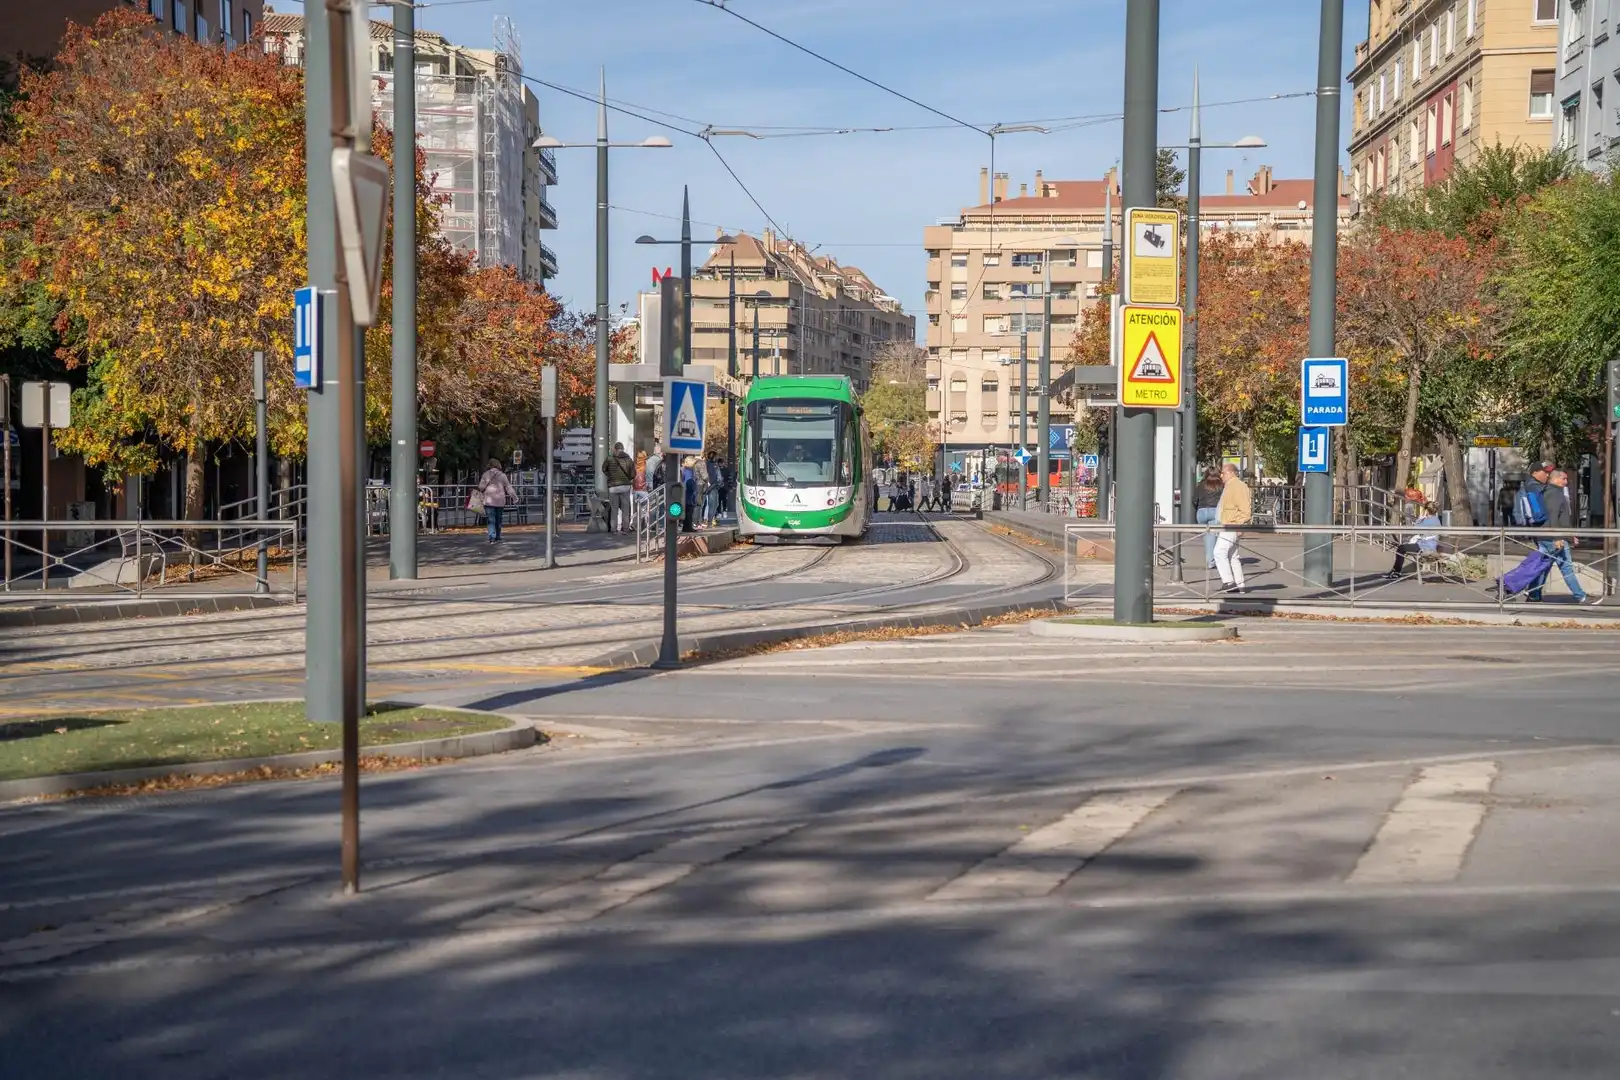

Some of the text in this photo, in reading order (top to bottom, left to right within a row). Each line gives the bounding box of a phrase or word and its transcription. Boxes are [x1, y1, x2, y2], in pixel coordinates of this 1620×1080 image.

[1129, 312, 1176, 326] ATENCIÓN
[1135, 389, 1168, 399] METRO
[1307, 406, 1343, 414] PARADA
[1309, 439, 1317, 452] 1
